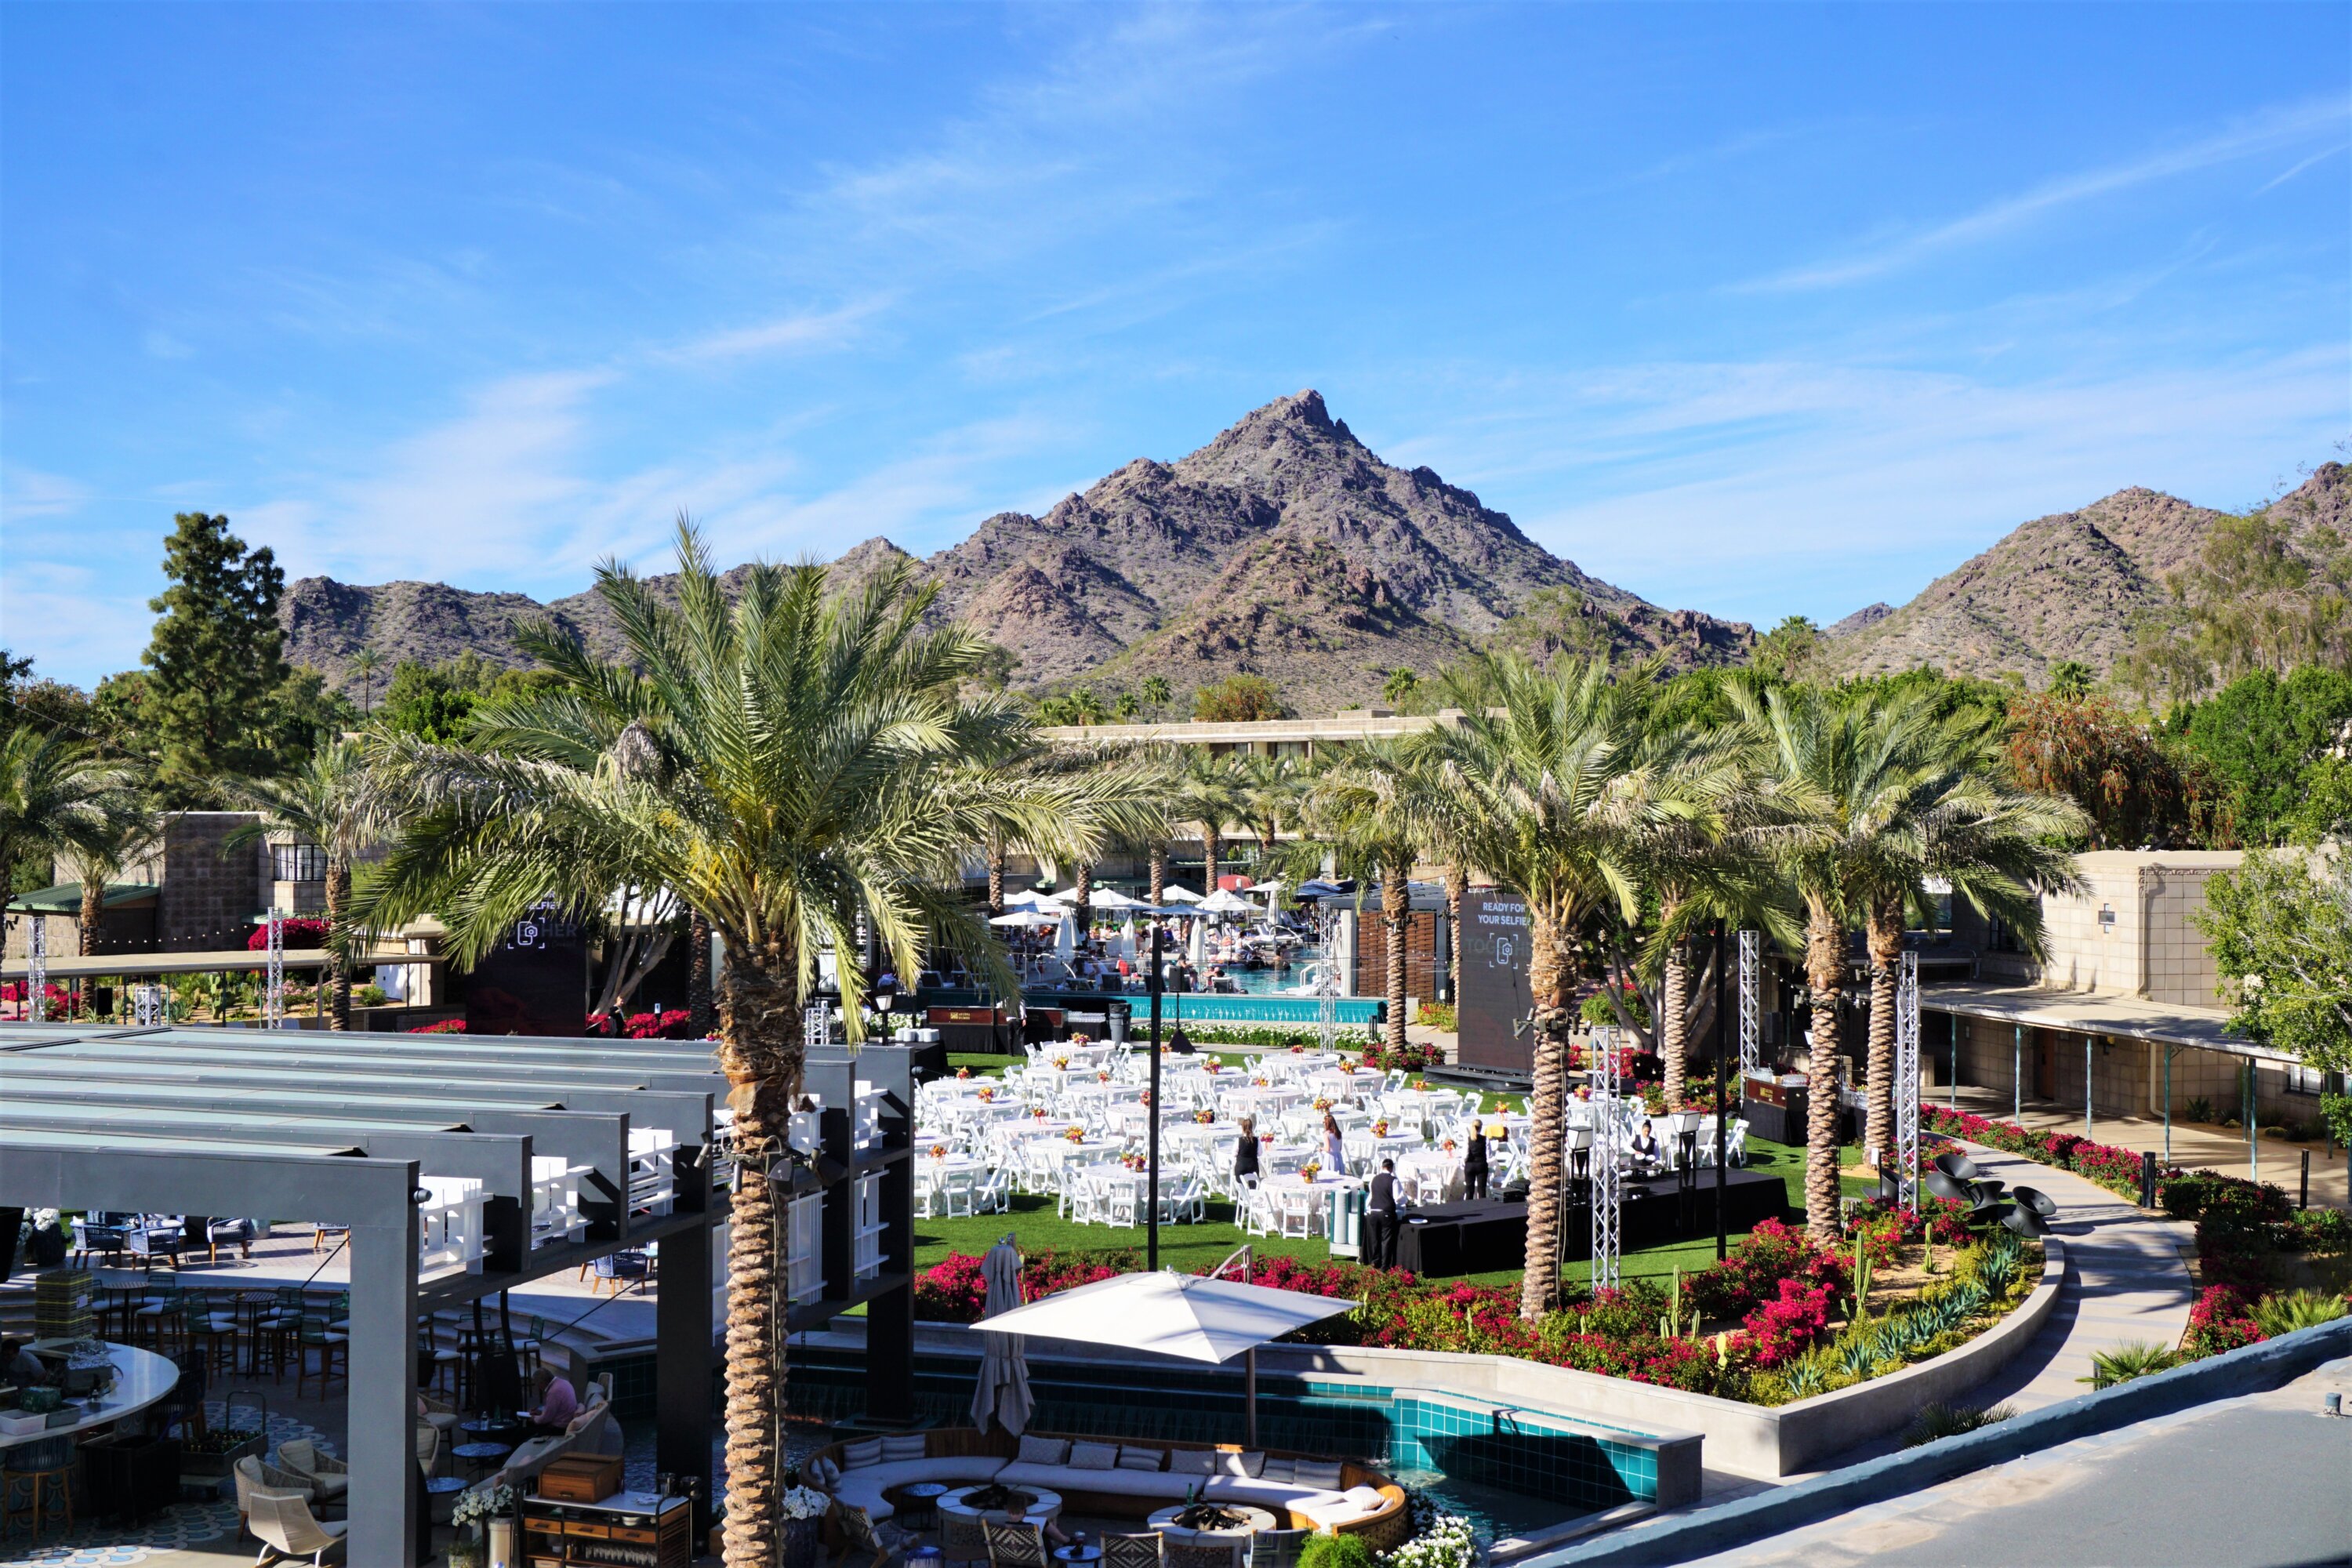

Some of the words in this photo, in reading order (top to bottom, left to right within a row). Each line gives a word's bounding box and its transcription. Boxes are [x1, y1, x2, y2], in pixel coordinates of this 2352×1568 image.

[1483, 902, 1508, 912] READY
[1510, 903, 1526, 913] FOR
[1478, 914, 1499, 924] YOUR
